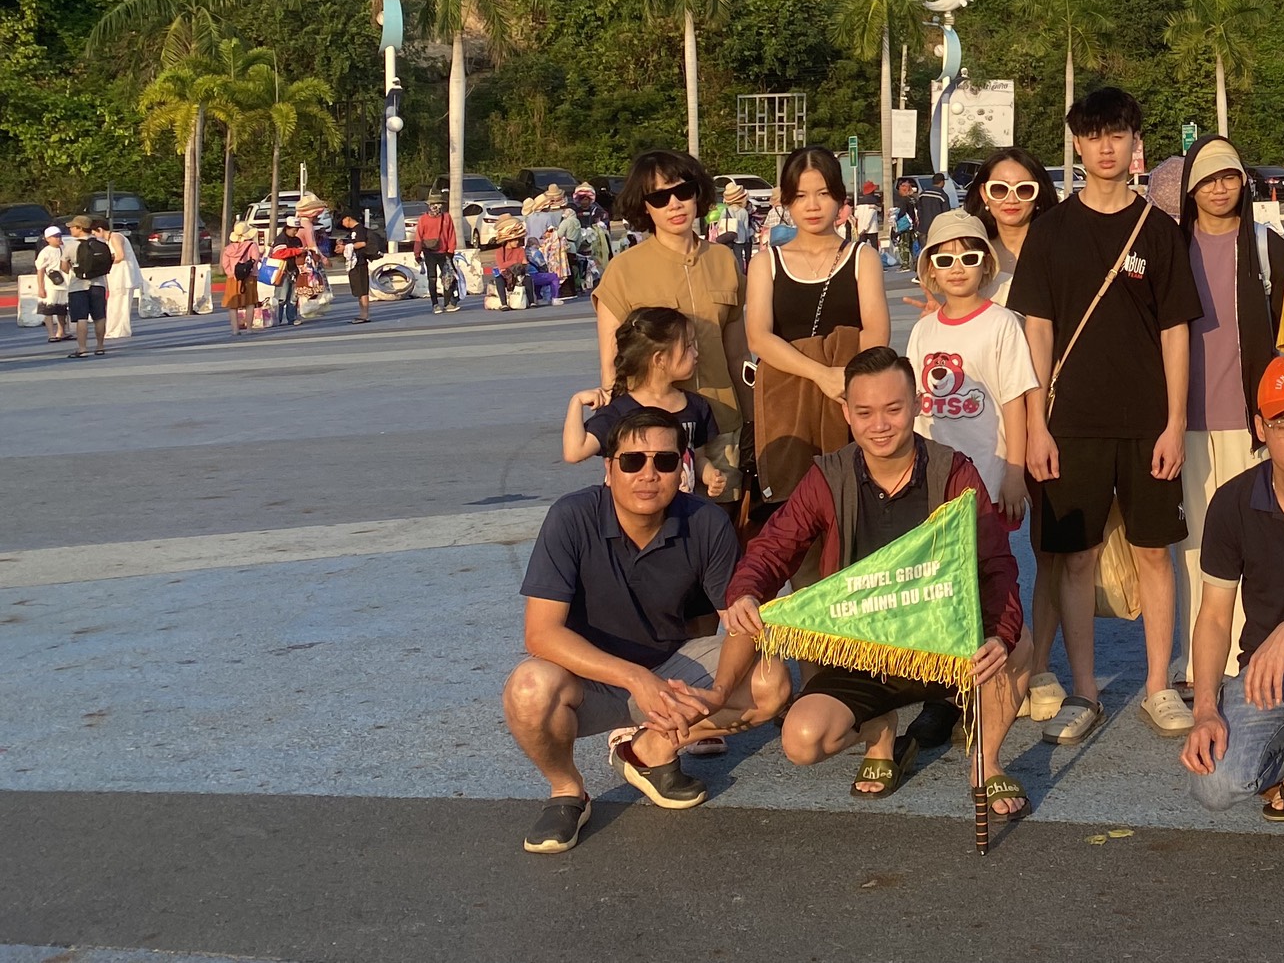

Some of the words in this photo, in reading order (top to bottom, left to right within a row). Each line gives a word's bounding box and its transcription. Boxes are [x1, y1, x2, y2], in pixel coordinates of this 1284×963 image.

[921, 396, 981, 416] OTSO
[845, 570, 893, 593] TRAVEL
[895, 560, 941, 583] GROUP
[861, 593, 898, 614] MINH
[901, 588, 920, 606] DU
